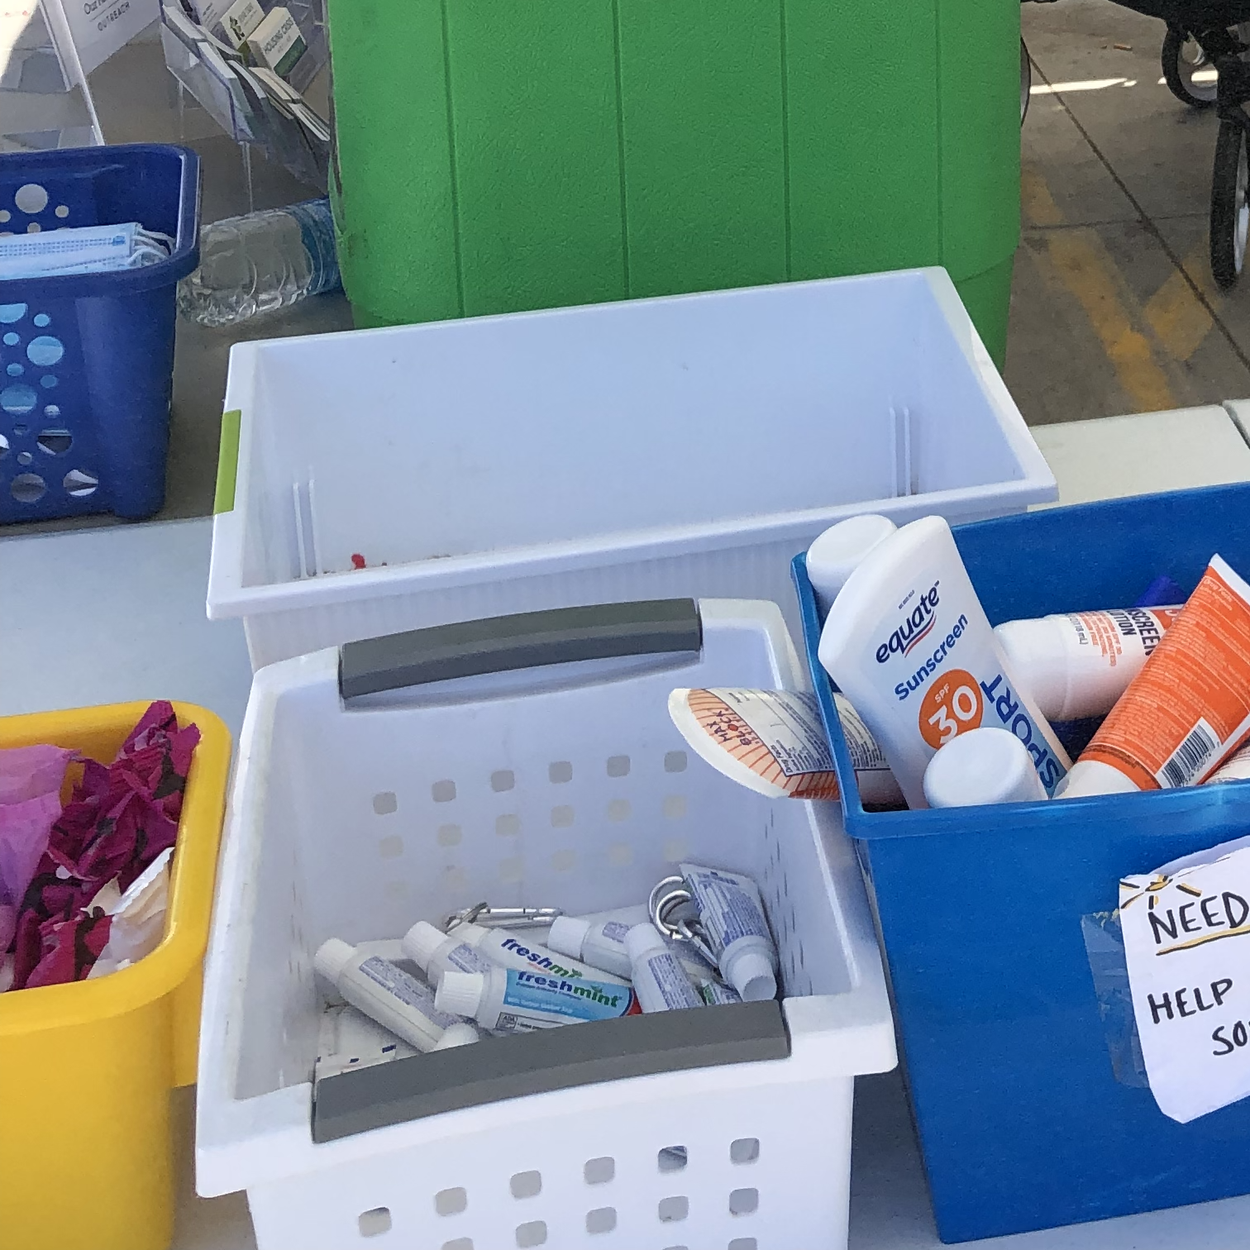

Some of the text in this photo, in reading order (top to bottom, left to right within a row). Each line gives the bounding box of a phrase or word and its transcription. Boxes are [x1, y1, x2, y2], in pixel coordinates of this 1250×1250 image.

[83, 0, 98, 15] Our
[97, 1, 131, 32] OUTREACH
[876, 584, 941, 664] equate
[894, 614, 969, 700] Sunscreen
[934, 683, 950, 703] SPF
[706, 720, 731, 742] MAX
[712, 707, 752, 747] BLOCK
[928, 685, 978, 745] 30
[980, 674, 1060, 789] SPORT
[1147, 891, 1250, 945] NEED
[516, 970, 620, 1009] freshmint
[1147, 978, 1233, 1025] HELP
